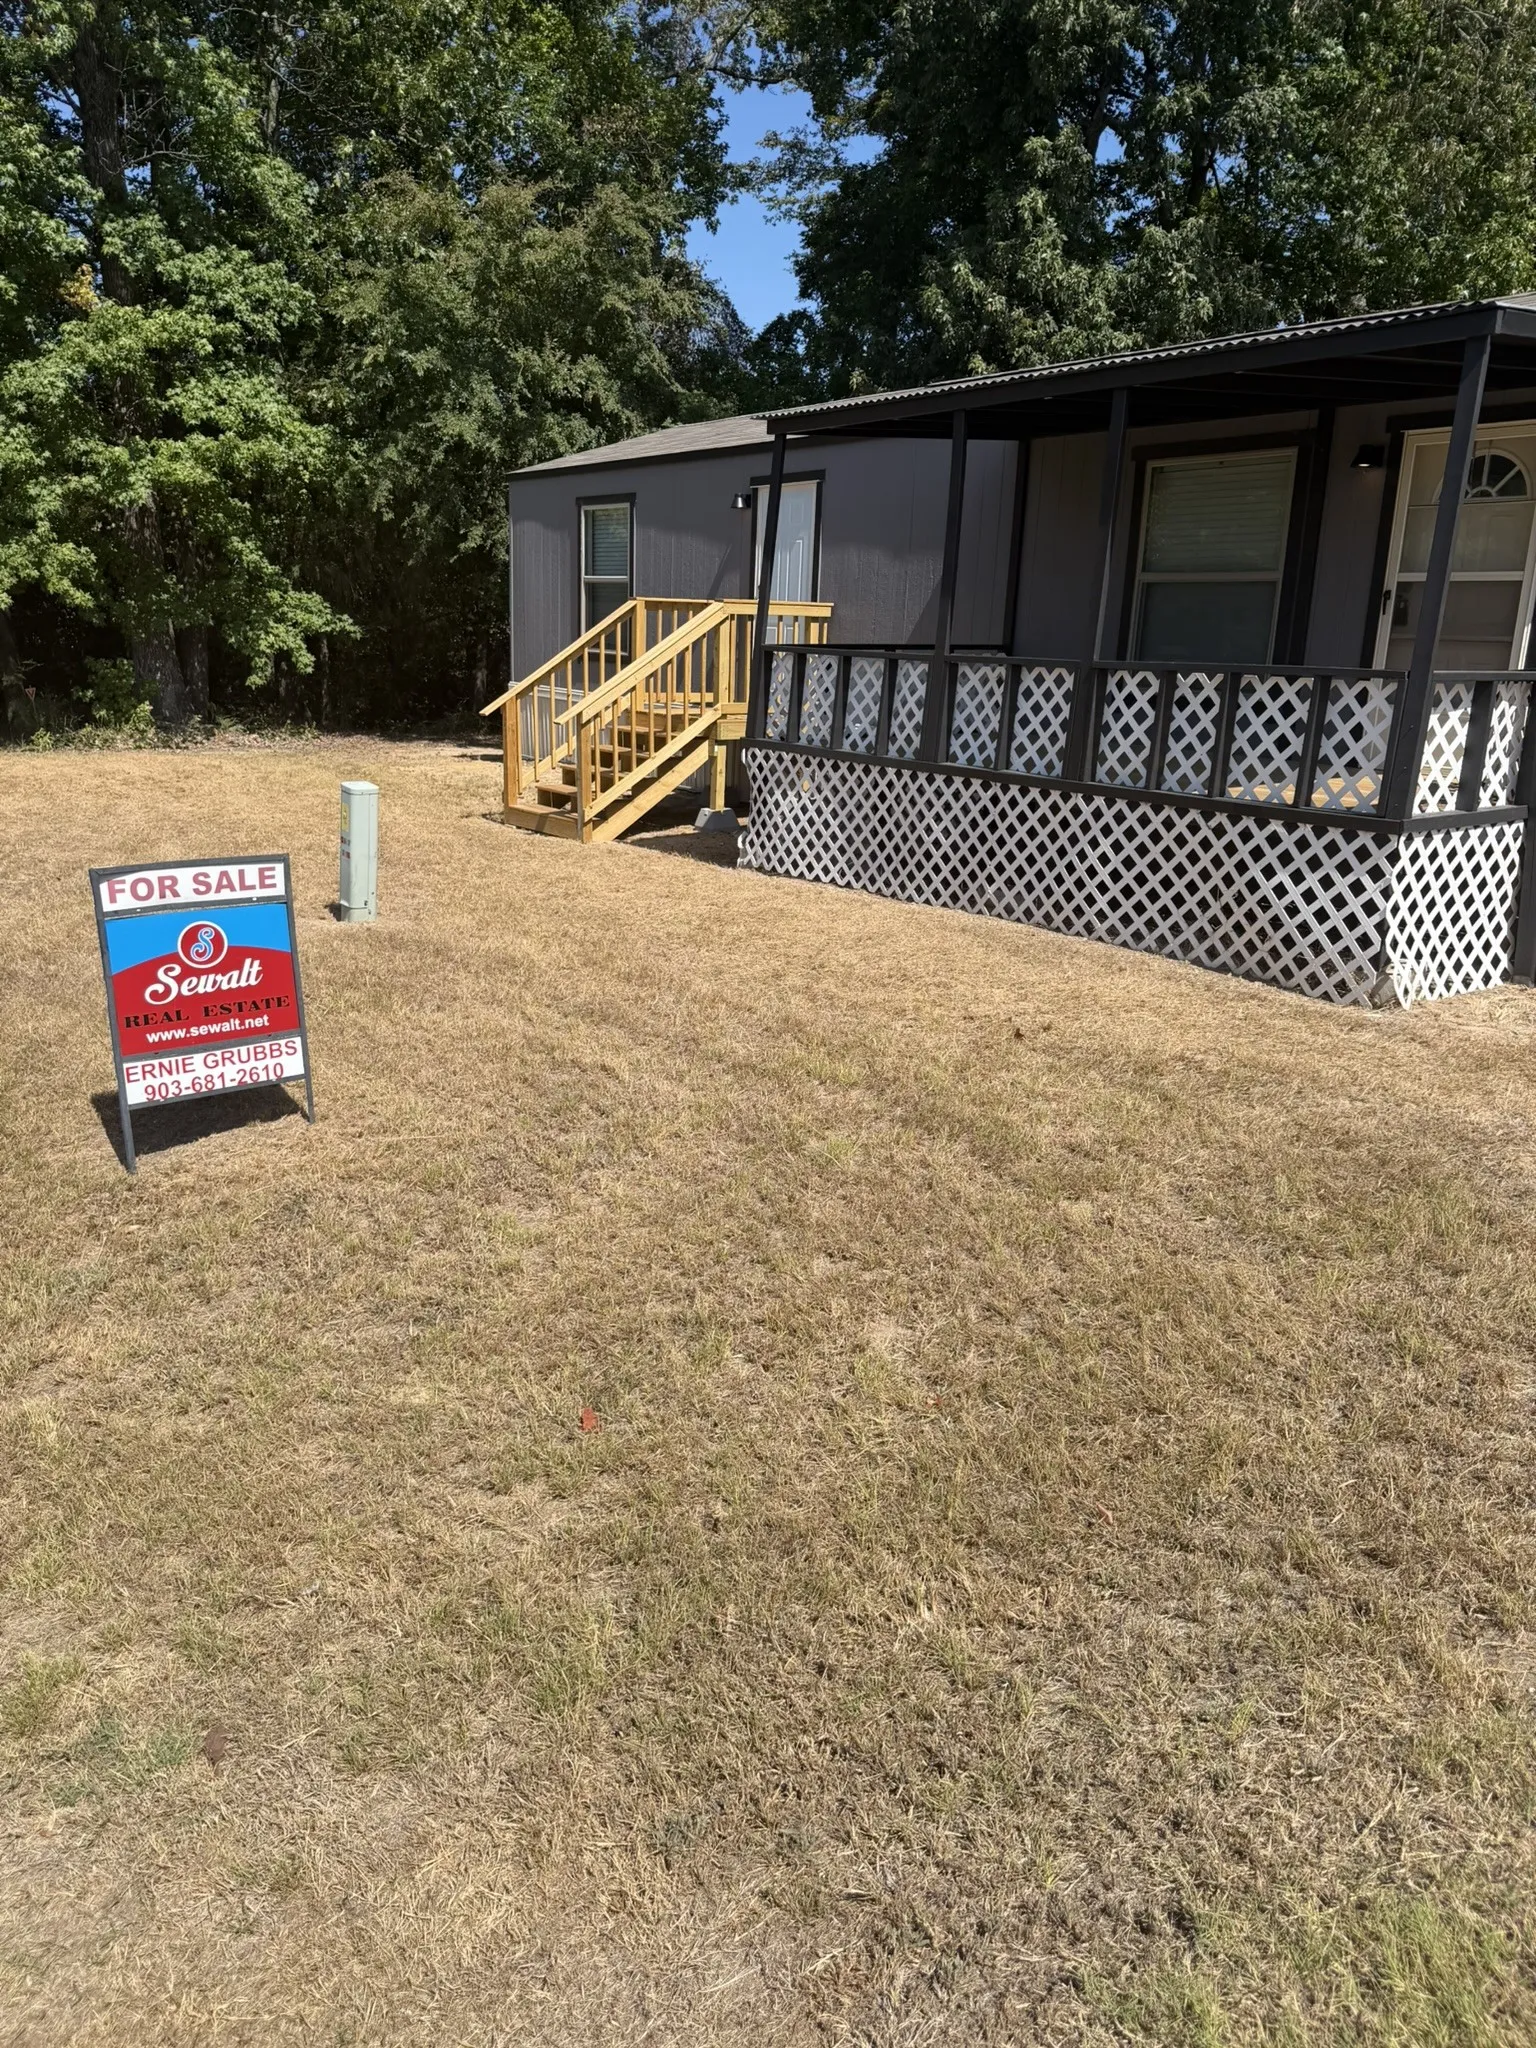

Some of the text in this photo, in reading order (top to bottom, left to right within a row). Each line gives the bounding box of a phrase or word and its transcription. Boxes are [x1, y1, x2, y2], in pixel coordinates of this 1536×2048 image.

[108, 866, 277, 904] FOR SALE
[144, 958, 263, 1005] Sewalt
[124, 995, 291, 1029] REAL ESTATE
[146, 1015, 270, 1043] www.sewalt.net
[125, 1040, 298, 1084] ERNIE GRUBBS
[144, 1062, 284, 1102] 903-681-2610
